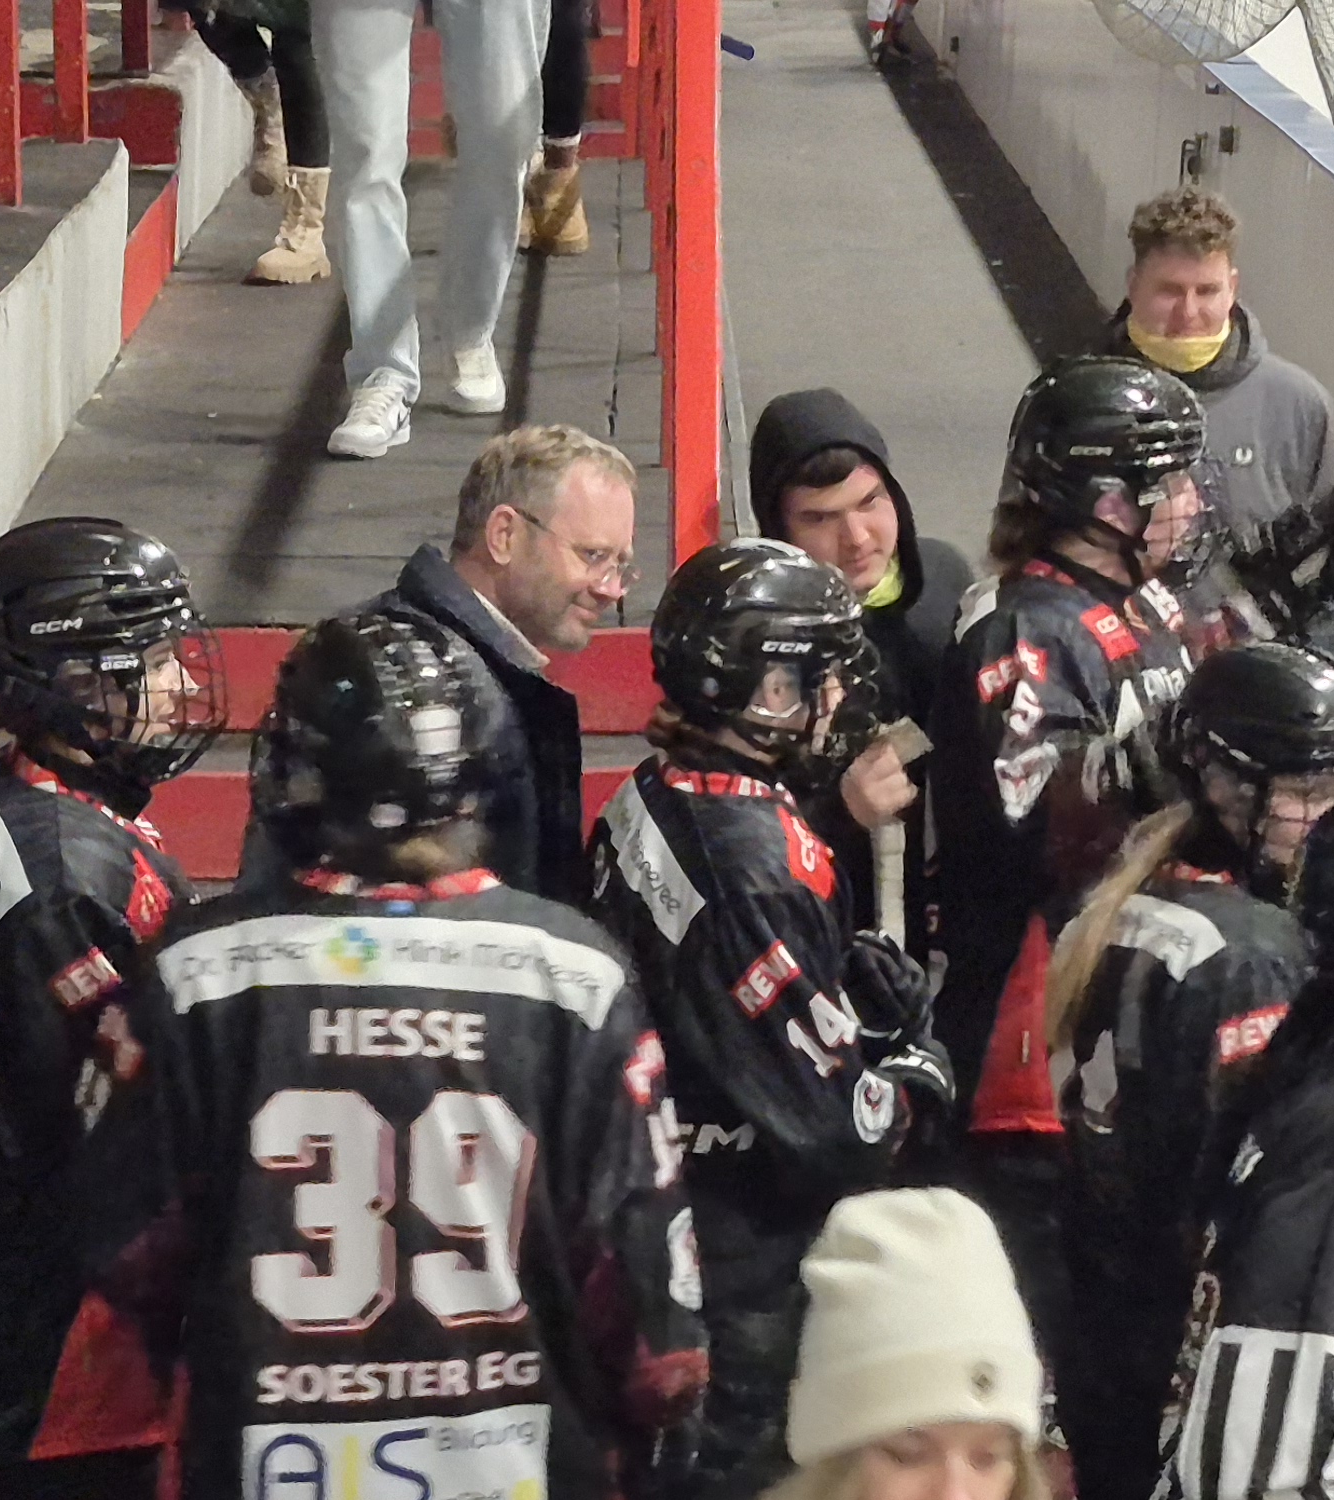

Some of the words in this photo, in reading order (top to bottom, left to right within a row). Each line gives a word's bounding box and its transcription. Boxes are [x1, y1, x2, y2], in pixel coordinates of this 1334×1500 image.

[30, 616, 83, 635] CCM
[761, 640, 813, 654] CCM
[735, 943, 797, 1012] REW
[309, 1007, 486, 1062] HESSE
[785, 990, 859, 1079] 14
[249, 1087, 538, 1334] 39
[255, 1358, 471, 1404] SOESTER
[476, 1350, 543, 1390] EG
